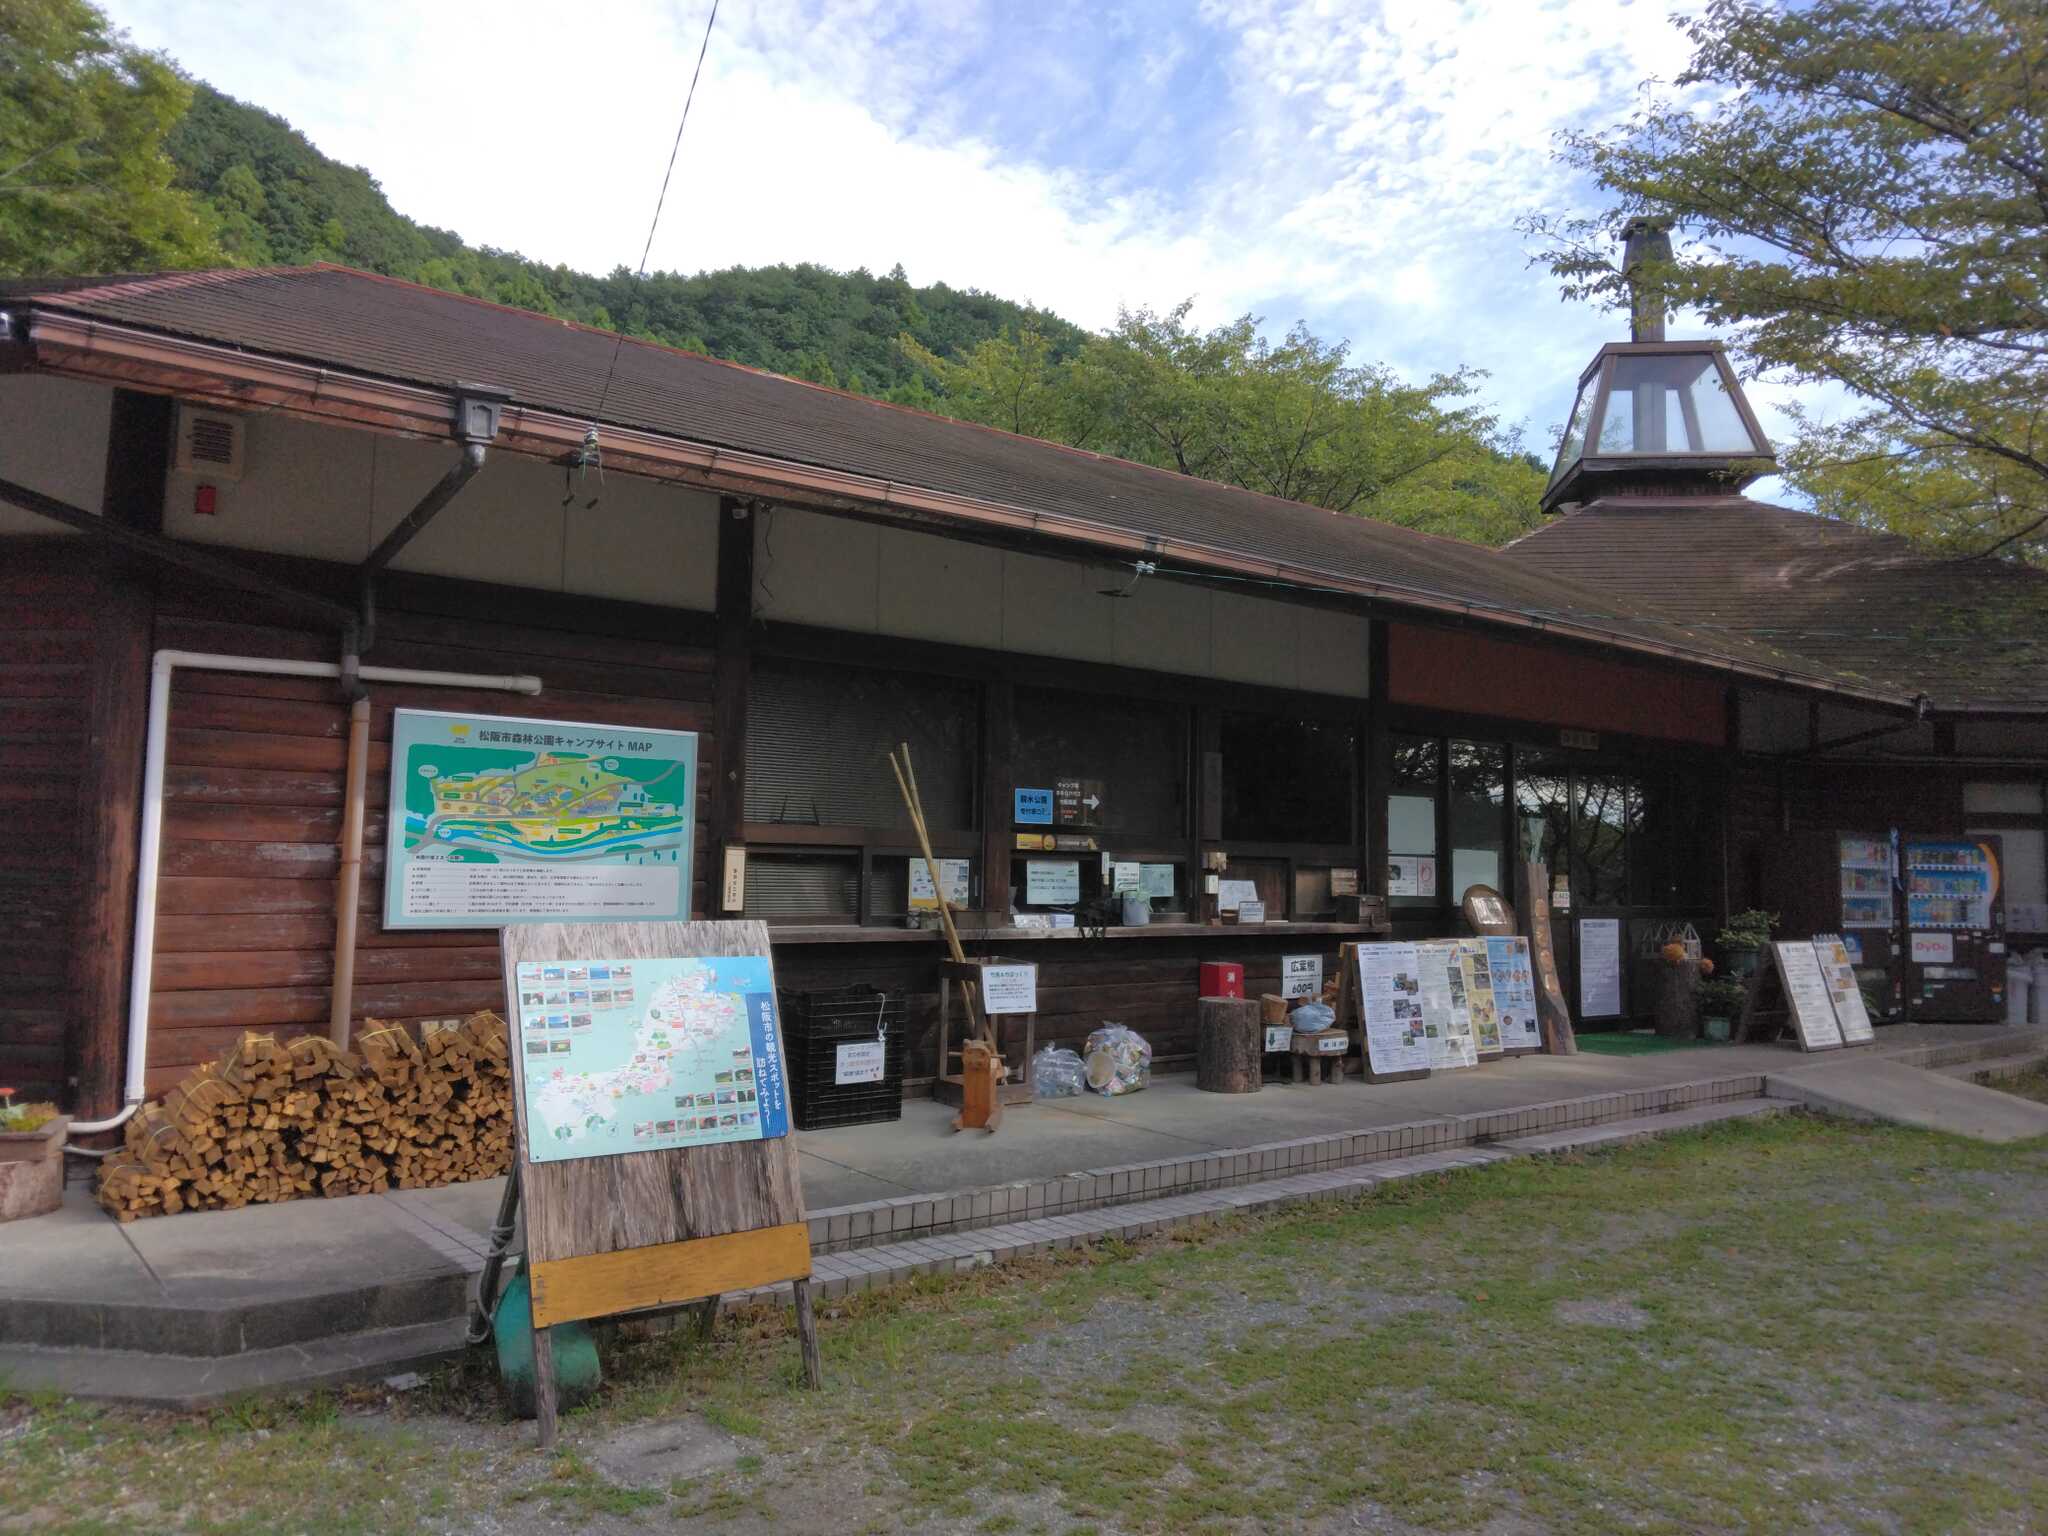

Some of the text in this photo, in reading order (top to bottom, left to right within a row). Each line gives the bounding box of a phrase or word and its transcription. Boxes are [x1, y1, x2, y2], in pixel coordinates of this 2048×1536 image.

[479, 730, 624, 750] 松阪市森林公園キャンプサイト
[628, 740, 653, 752] MAP
[1915, 942, 1948, 952] DyDo
[1290, 959, 1316, 973] 広葉樹
[760, 1001, 782, 1110] 松阪市の観光スポットを
